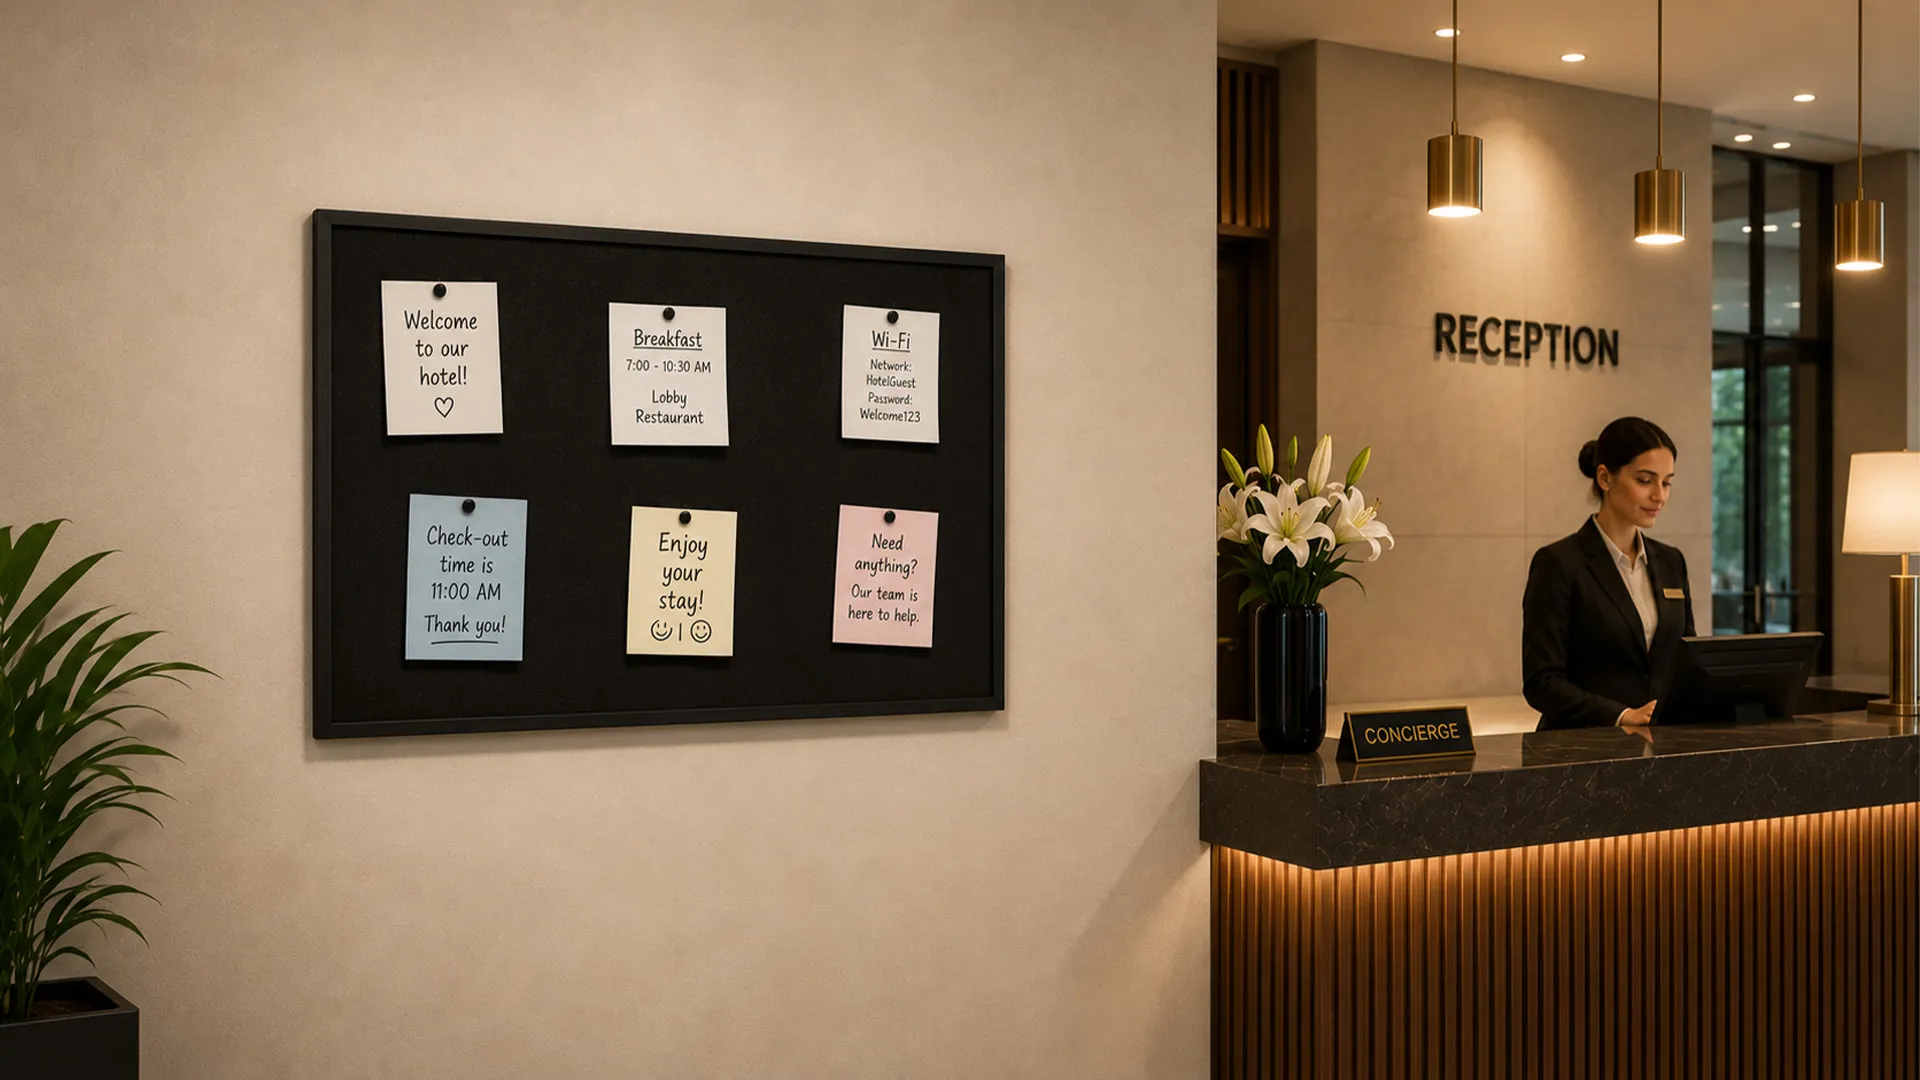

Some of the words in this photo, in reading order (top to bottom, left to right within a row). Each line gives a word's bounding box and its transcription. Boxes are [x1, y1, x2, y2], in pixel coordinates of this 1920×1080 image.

[404, 309, 477, 330] Welcome
[415, 339, 433, 357] to
[441, 344, 469, 357] our
[633, 328, 702, 348] Breakfast
[872, 330, 910, 349] Wi-Fi
[1435, 312, 1619, 366] RECEPTION
[420, 365, 466, 385] hotel!
[626, 359, 650, 371] 7:00
[663, 360, 690, 372] 10:30
[694, 361, 711, 373] AM
[871, 359, 911, 372] Network:
[866, 374, 916, 388] HotelGuest
[652, 389, 687, 409] Lobby
[636, 409, 704, 424] Restaurant
[860, 408, 920, 422] Welcome123
[427, 525, 508, 547] Check-out
[659, 532, 707, 560] Enjoy
[872, 533, 903, 550] Need
[440, 556, 474, 573] time
[482, 557, 493, 573] is
[855, 557, 918, 580] anything?
[662, 567, 703, 587] your
[432, 583, 469, 600] 11:00
[476, 583, 500, 600] AM
[851, 584, 872, 598] Our
[877, 587, 904, 600] team
[910, 589, 918, 602] is
[659, 590, 703, 617] stay!
[848, 604, 873, 620] here
[878, 608, 890, 621] to
[894, 608, 919, 627] help.
[424, 614, 469, 632] Thank
[476, 615, 505, 639] you!
[1364, 722, 1461, 745] CONCIERGE
